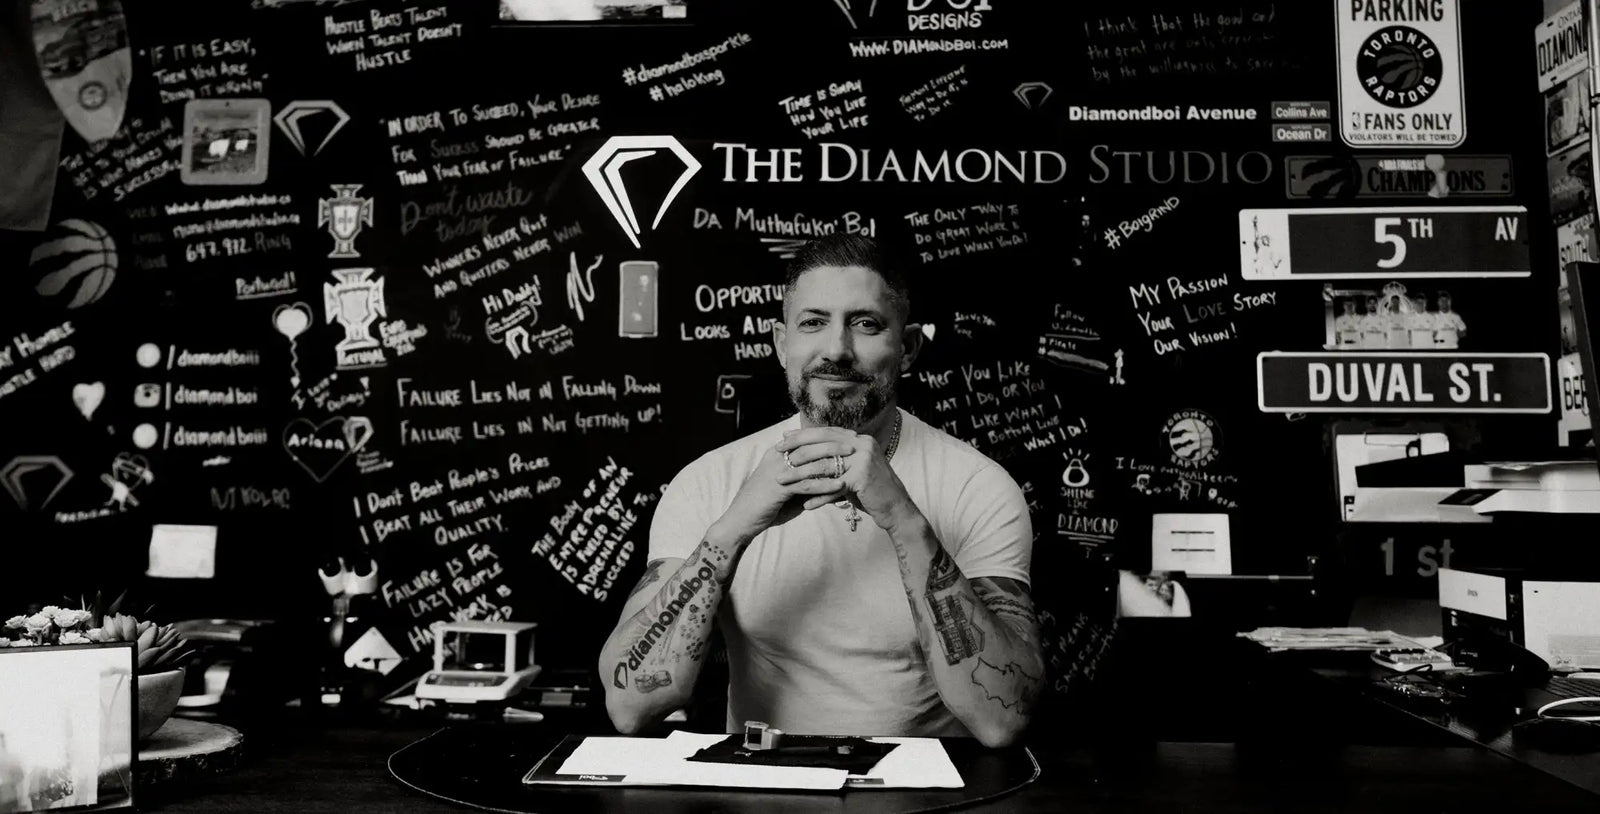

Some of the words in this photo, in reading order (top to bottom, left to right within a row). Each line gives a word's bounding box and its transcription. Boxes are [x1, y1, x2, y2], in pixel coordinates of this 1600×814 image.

[324, 15, 366, 36] HUSTLE
[369, 8, 402, 31] BEATS
[404, 6, 447, 26] TALENT
[907, 12, 983, 32] DESIGNS
[1351, 0, 1444, 21] PARKING
[326, 36, 365, 55] WHEN
[368, 32, 412, 48] TALENT
[1363, 29, 1435, 59] TORONTO
[355, 48, 412, 72] HUSTLE
[1365, 75, 1437, 104] RAPTORS
[404, 111, 445, 133] ORDER
[449, 108, 468, 126] TO
[527, 94, 558, 119] YOUR
[561, 93, 600, 111] DESIRE
[838, 114, 869, 130] LIFE
[1069, 105, 1181, 121] Diamondboi
[1186, 105, 1257, 120] Avenue
[1275, 106, 1307, 118] Collins
[1309, 106, 1328, 118] Ave
[1364, 113, 1406, 130] FANS
[1412, 113, 1453, 130] ONLY
[1276, 127, 1311, 140] Ocean
[1313, 127, 1327, 140] Dr
[1349, 133, 1393, 141] VIOLATORS
[1396, 133, 1414, 141] WILL
[1417, 133, 1427, 141] BE
[1430, 132, 1458, 141] TOWED
[391, 145, 417, 164] FOR
[713, 142, 803, 183] THE
[818, 142, 1067, 184] DIAMOND
[1089, 145, 1273, 184] STUDIO
[432, 163, 462, 181] YOUR
[1367, 167, 1486, 192] CHAMPONS
[694, 207, 722, 230] DA
[904, 212, 930, 229] THE
[933, 208, 966, 224] ONLY
[1495, 217, 1519, 241] AV
[482, 227, 521, 251] NEVER
[1183, 302, 1226, 324] LOVE
[1233, 291, 1277, 312] STORY
[680, 322, 731, 341] LOOKS
[743, 315, 755, 335] A
[734, 341, 774, 361] HARD
[397, 377, 463, 408] FAILURE
[470, 379, 502, 404] LIES
[506, 381, 531, 401] NOT
[539, 380, 553, 401] IN
[562, 375, 616, 400] FALLING
[623, 374, 661, 396] DOWN
[1308, 362, 1434, 402] DUVAL
[1448, 362, 1503, 402] ST.
[400, 419, 463, 446] FAILURE
[473, 421, 505, 439] LIES
[516, 415, 534, 434] IN
[542, 413, 568, 433] NOT
[575, 411, 629, 434] GETTING
[637, 402, 663, 424] UP!
[353, 496, 362, 518] I
[359, 525, 370, 545] I
[373, 514, 412, 543] BEAT
[419, 508, 443, 527] ALL
[447, 496, 486, 518] THEIR
[488, 485, 533, 504] WORK
[1057, 512, 1119, 535] DIAMOND
[530, 532, 557, 558] THE
[1417, 538, 1455, 578] st
[381, 568, 441, 608] FAILURE
[407, 587, 454, 618] LAZY
[628, 558, 716, 671] diamondboi
